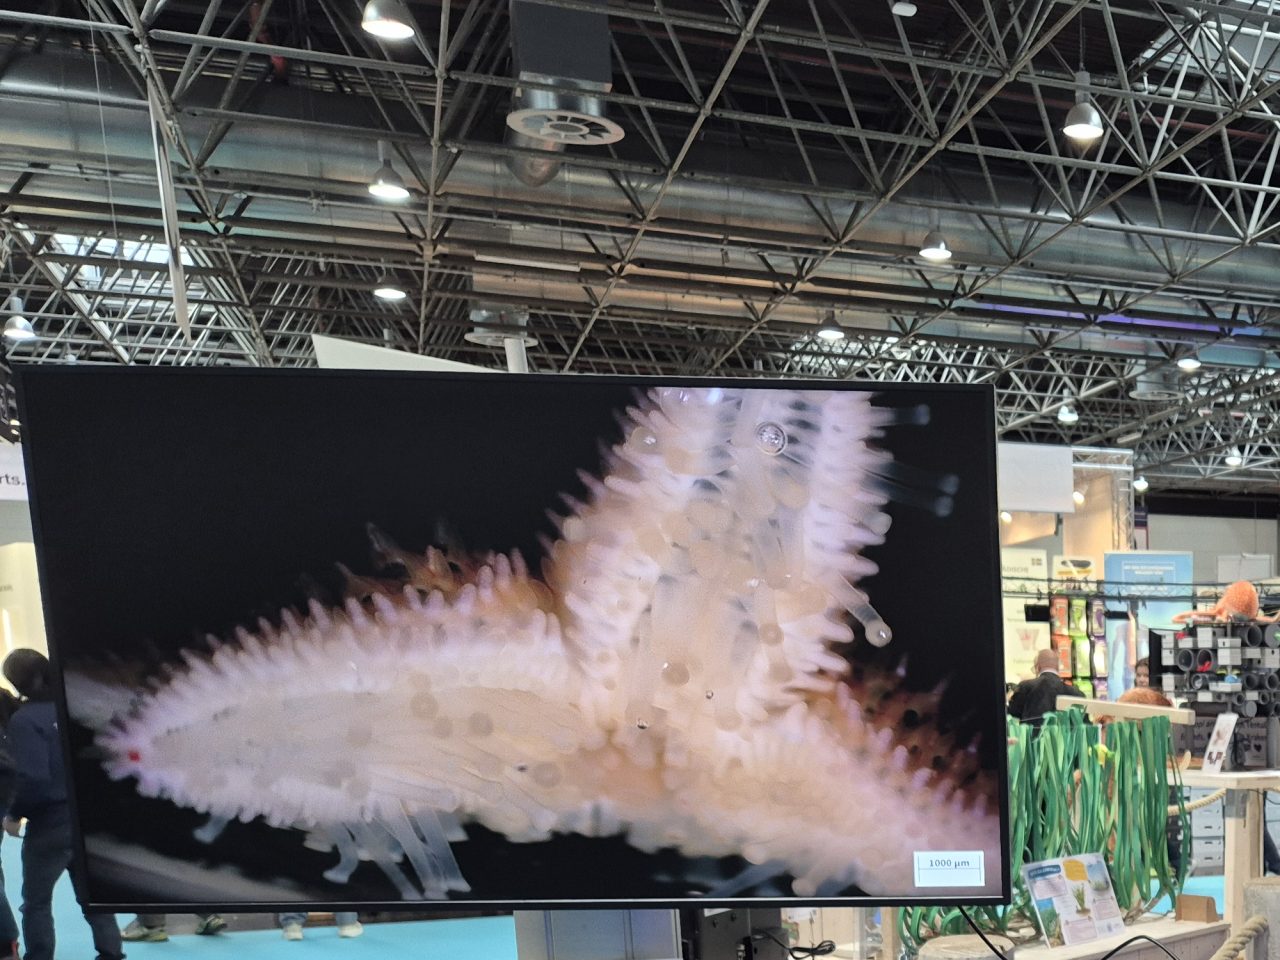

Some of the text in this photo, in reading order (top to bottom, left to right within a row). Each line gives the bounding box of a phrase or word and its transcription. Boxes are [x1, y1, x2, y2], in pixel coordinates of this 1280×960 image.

[0, 474, 26, 486] rts.
[929, 859, 970, 869] 1000 µm
